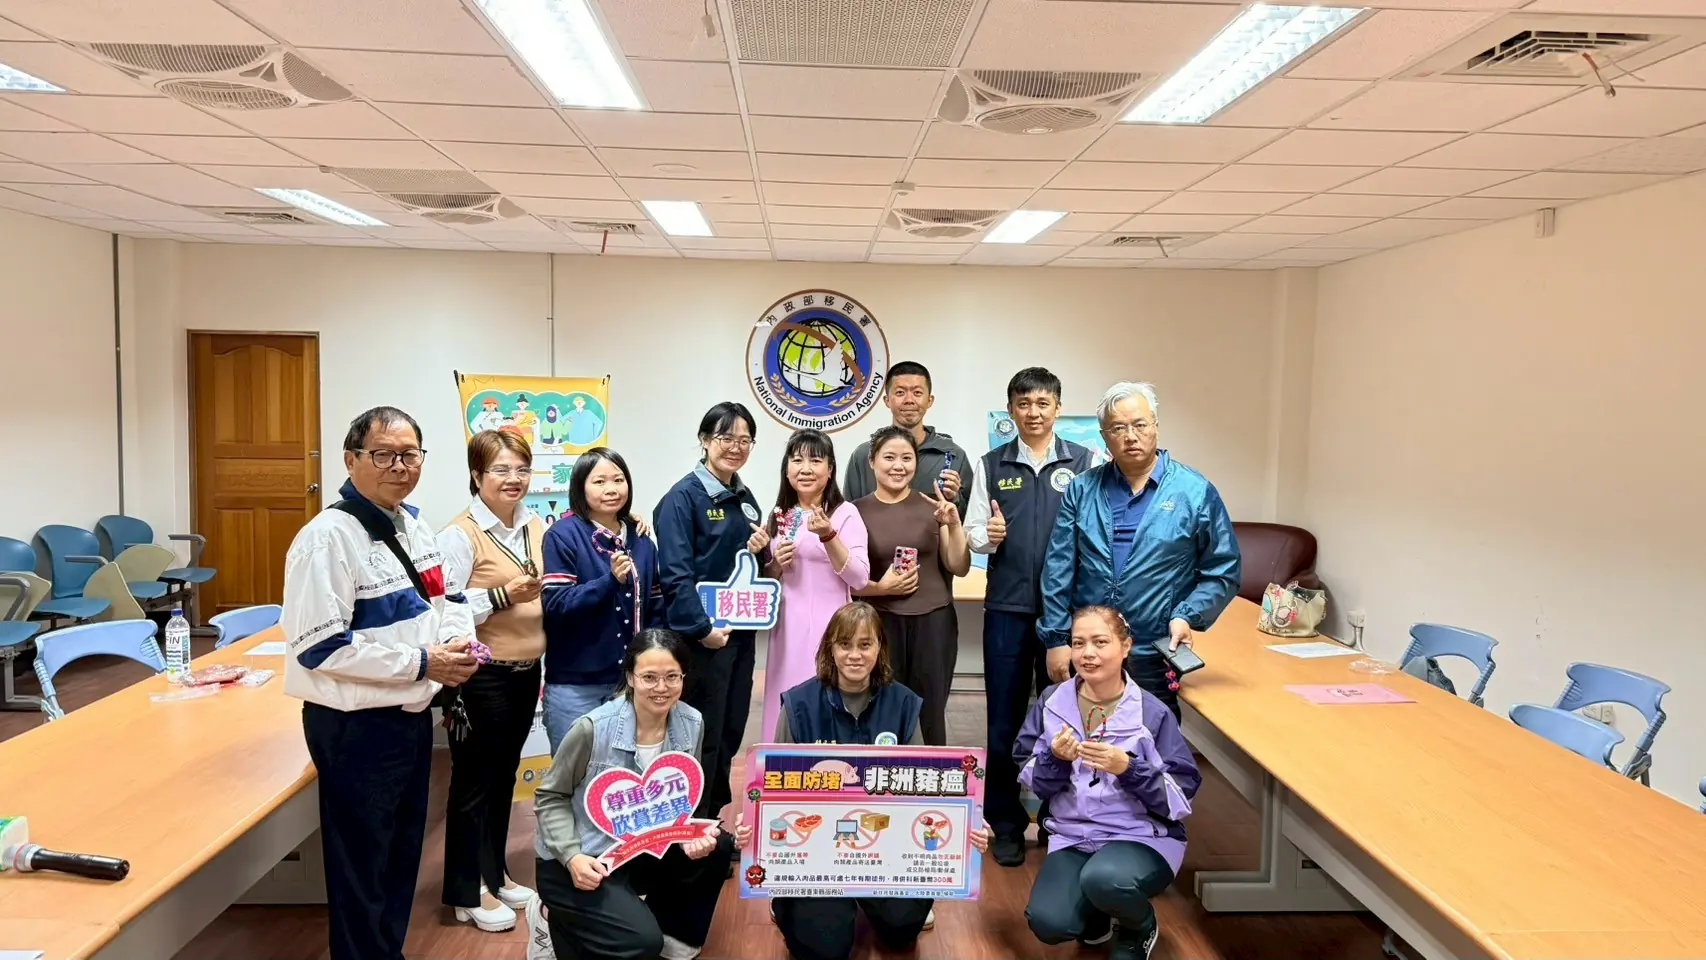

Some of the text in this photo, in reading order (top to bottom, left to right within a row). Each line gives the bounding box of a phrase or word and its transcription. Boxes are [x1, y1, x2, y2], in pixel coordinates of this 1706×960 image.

[766, 295, 871, 328] 內政部移民署
[754, 372, 884, 430] National Immigration Agency
[718, 590, 769, 618] 移民署
[605, 773, 687, 811] 尊重多元
[764, 765, 967, 796] 全面防堵 非洲豬瘟
[612, 795, 692, 837] 欣賞差異
